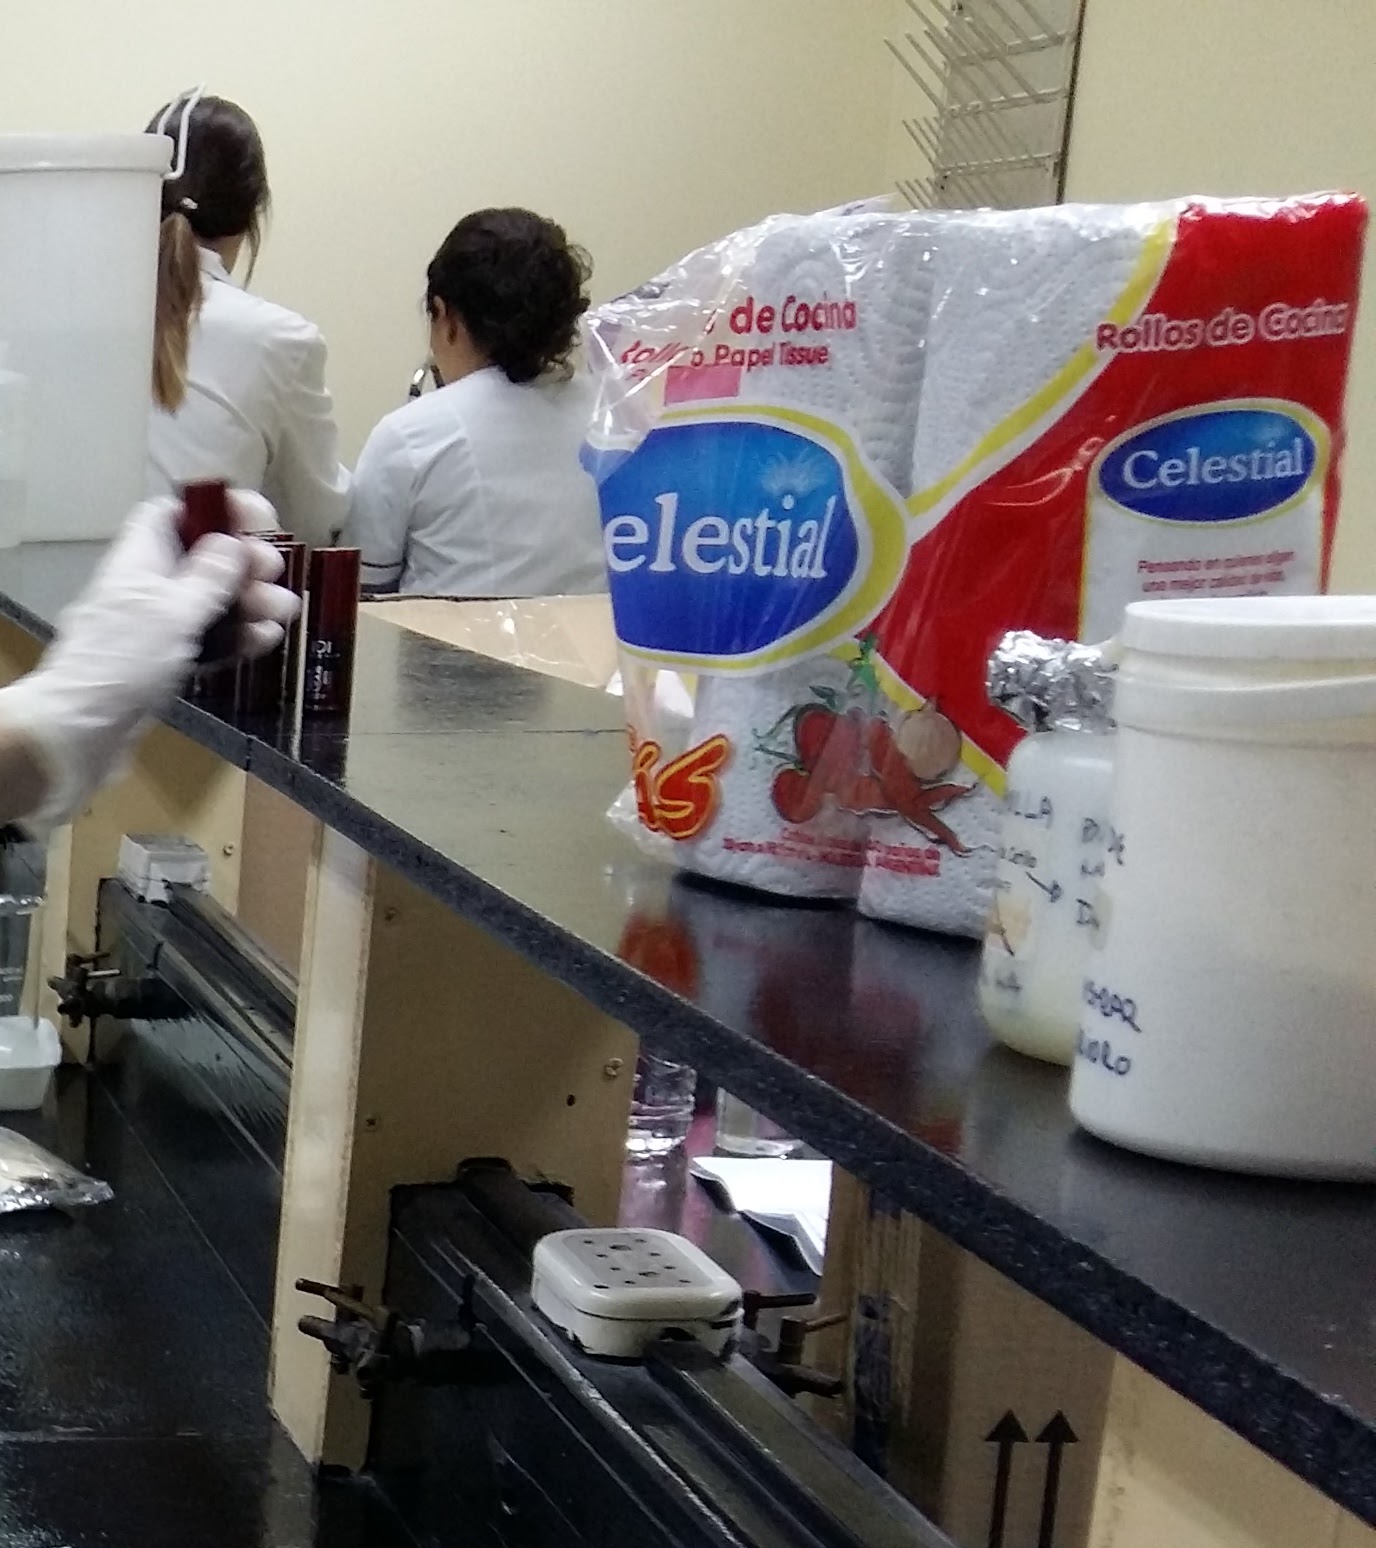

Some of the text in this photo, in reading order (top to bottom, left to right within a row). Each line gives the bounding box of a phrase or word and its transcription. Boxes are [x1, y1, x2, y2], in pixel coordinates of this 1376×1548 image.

[729, 292, 857, 334] de Cocina
[1098, 313, 1203, 352] Rollos
[1206, 307, 1255, 346] de
[714, 343, 776, 371] Papel
[780, 341, 830, 366] Tissue
[1122, 436, 1304, 489] Celestial
[604, 492, 837, 578] elestial
